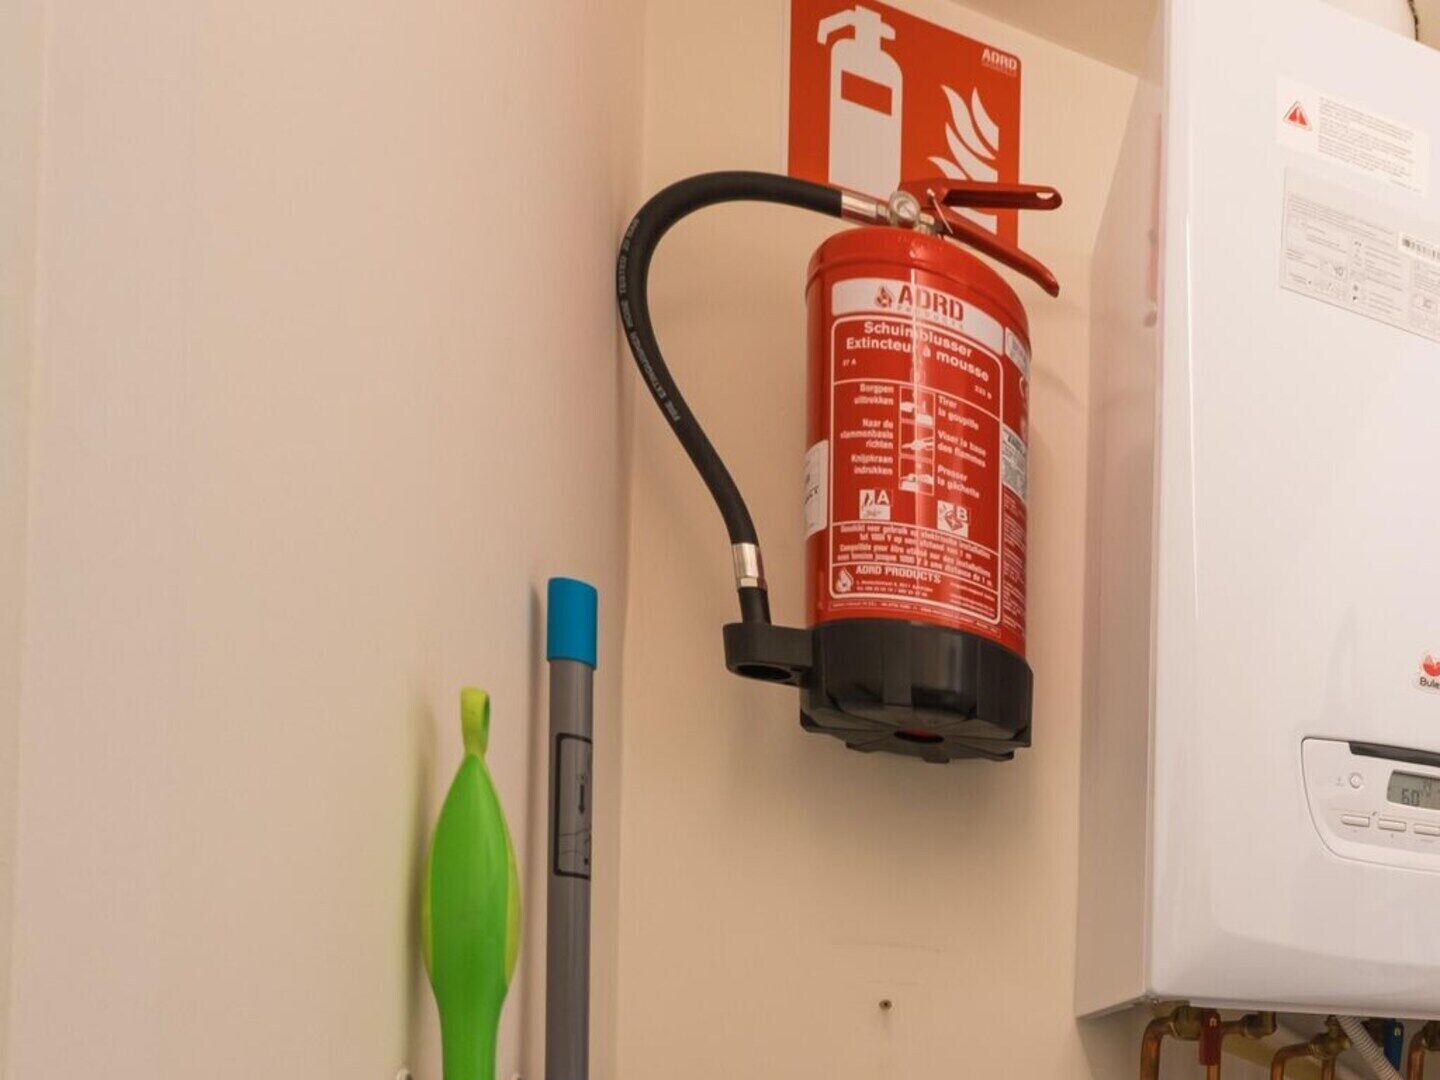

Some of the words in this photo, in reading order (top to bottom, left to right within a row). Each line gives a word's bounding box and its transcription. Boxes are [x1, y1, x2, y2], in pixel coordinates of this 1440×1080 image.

[936, 350, 990, 382] mousse
[877, 489, 889, 505] A
[957, 505, 968, 521] B
[885, 566, 941, 583] PRODUCTS
